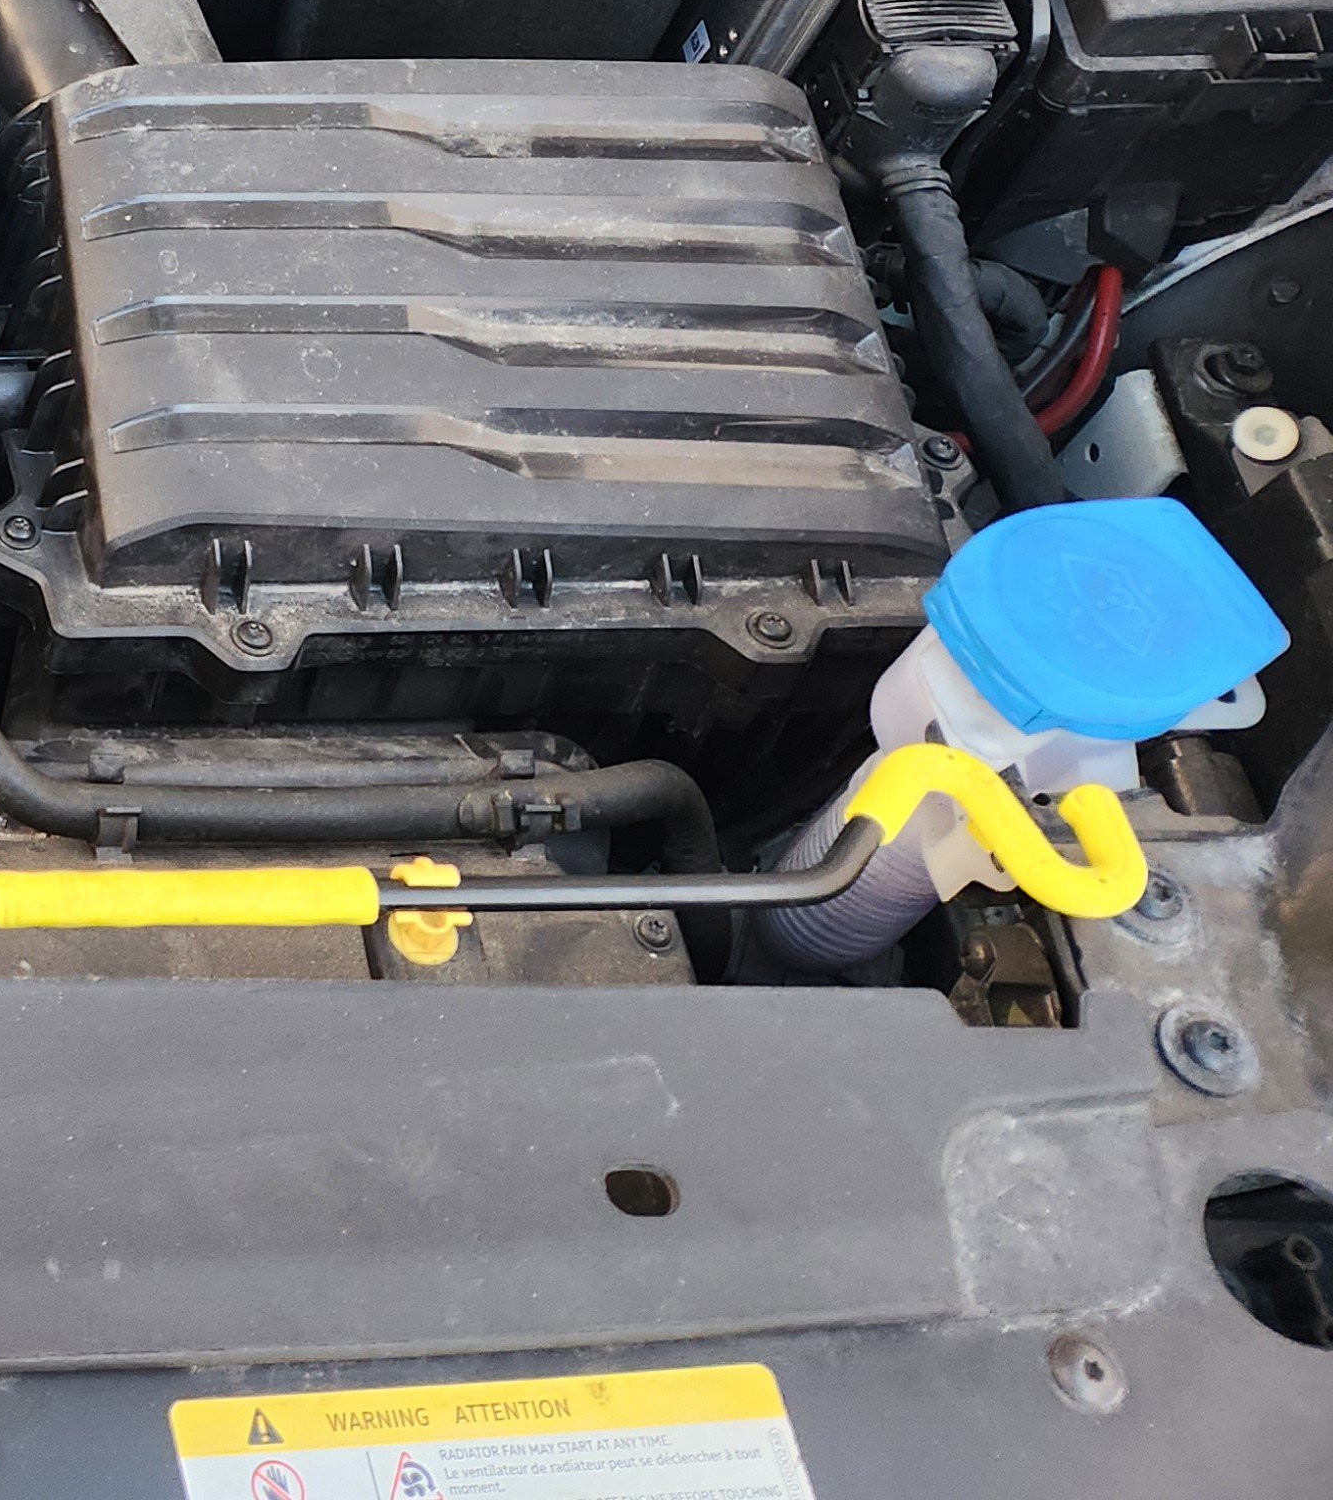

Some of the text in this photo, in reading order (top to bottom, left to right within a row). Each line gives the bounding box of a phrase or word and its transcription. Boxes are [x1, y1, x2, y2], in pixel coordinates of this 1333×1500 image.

[326, 1397, 572, 1433] WARNING ATTENTION
[439, 1445, 500, 1461] RADIATOR
[501, 1443, 528, 1457] FAN
[529, 1441, 555, 1456] MAY
[556, 1438, 594, 1454] START
[596, 1437, 613, 1452] AT
[613, 1435, 637, 1450] ANY
[444, 1467, 459, 1480] Le
[461, 1463, 528, 1479] ventilateur
[531, 1462, 547, 1475] de
[550, 1456, 606, 1474] radiateur
[609, 1455, 637, 1472] peut
[639, 1456, 653, 1467] se
[656, 1450, 722, 1467] déclencher
[734, 1447, 762, 1460] tout
[449, 1483, 506, 1496] moment.
[669, 1488, 717, 1500] BEFORE
[718, 1485, 783, 1500] TOUCHING
